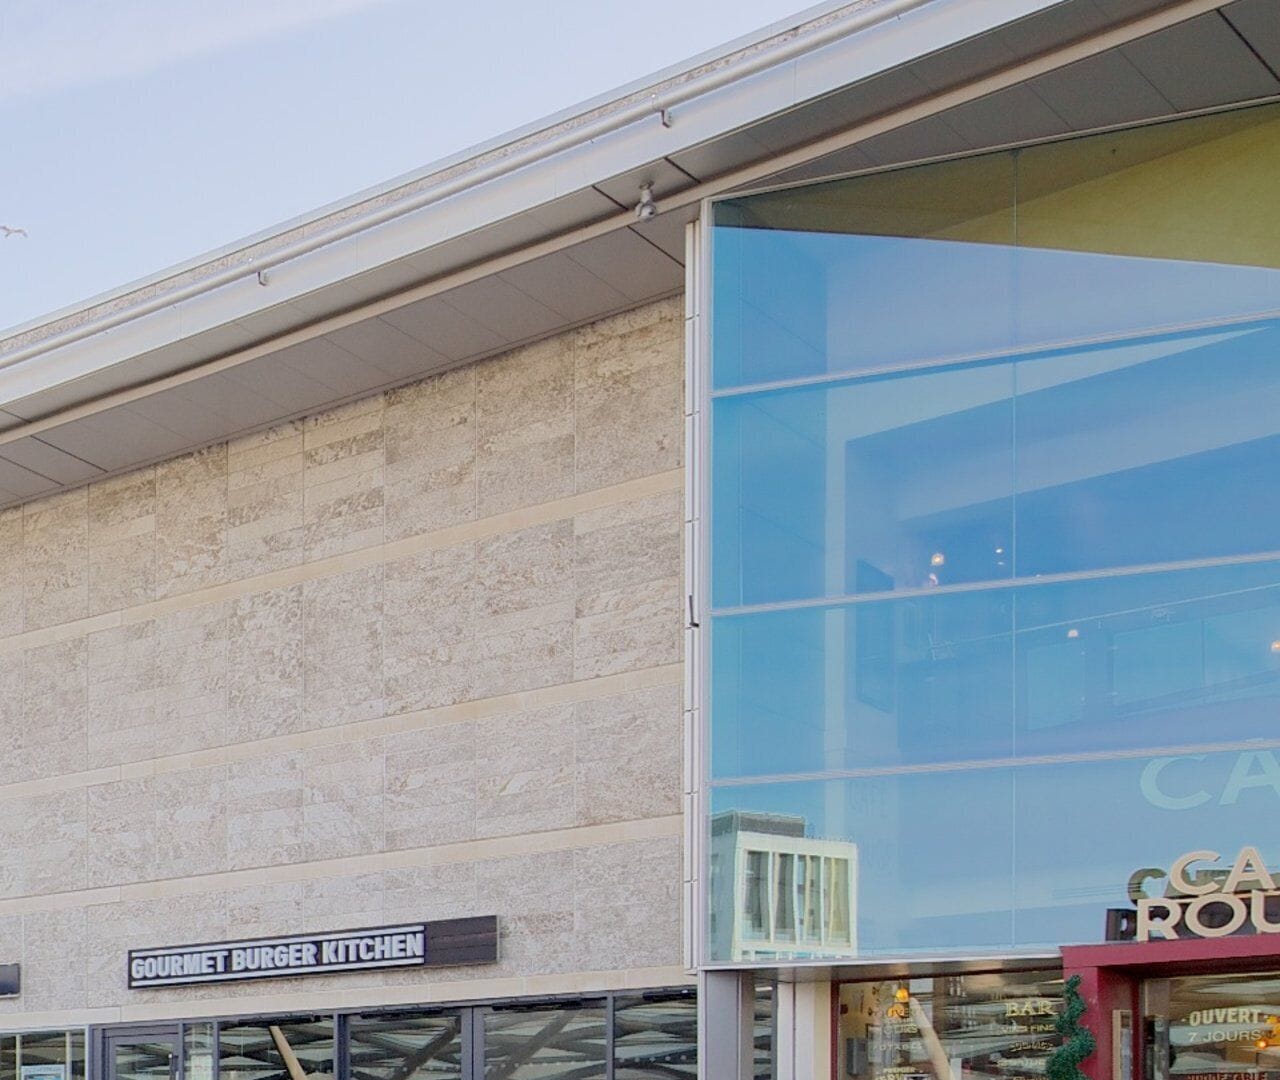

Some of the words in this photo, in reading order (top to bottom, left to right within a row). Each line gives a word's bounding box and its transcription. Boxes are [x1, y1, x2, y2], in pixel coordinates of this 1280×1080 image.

[1169, 846, 1277, 896] CA
[131, 951, 228, 980] GOURMET
[231, 943, 317, 972] BURGER
[322, 933, 425, 963] KITCHEN
[1189, 1008, 1261, 1027] OUVERT
[1187, 1032, 1199, 1043] 7
[1203, 1029, 1262, 1042] JOURS
